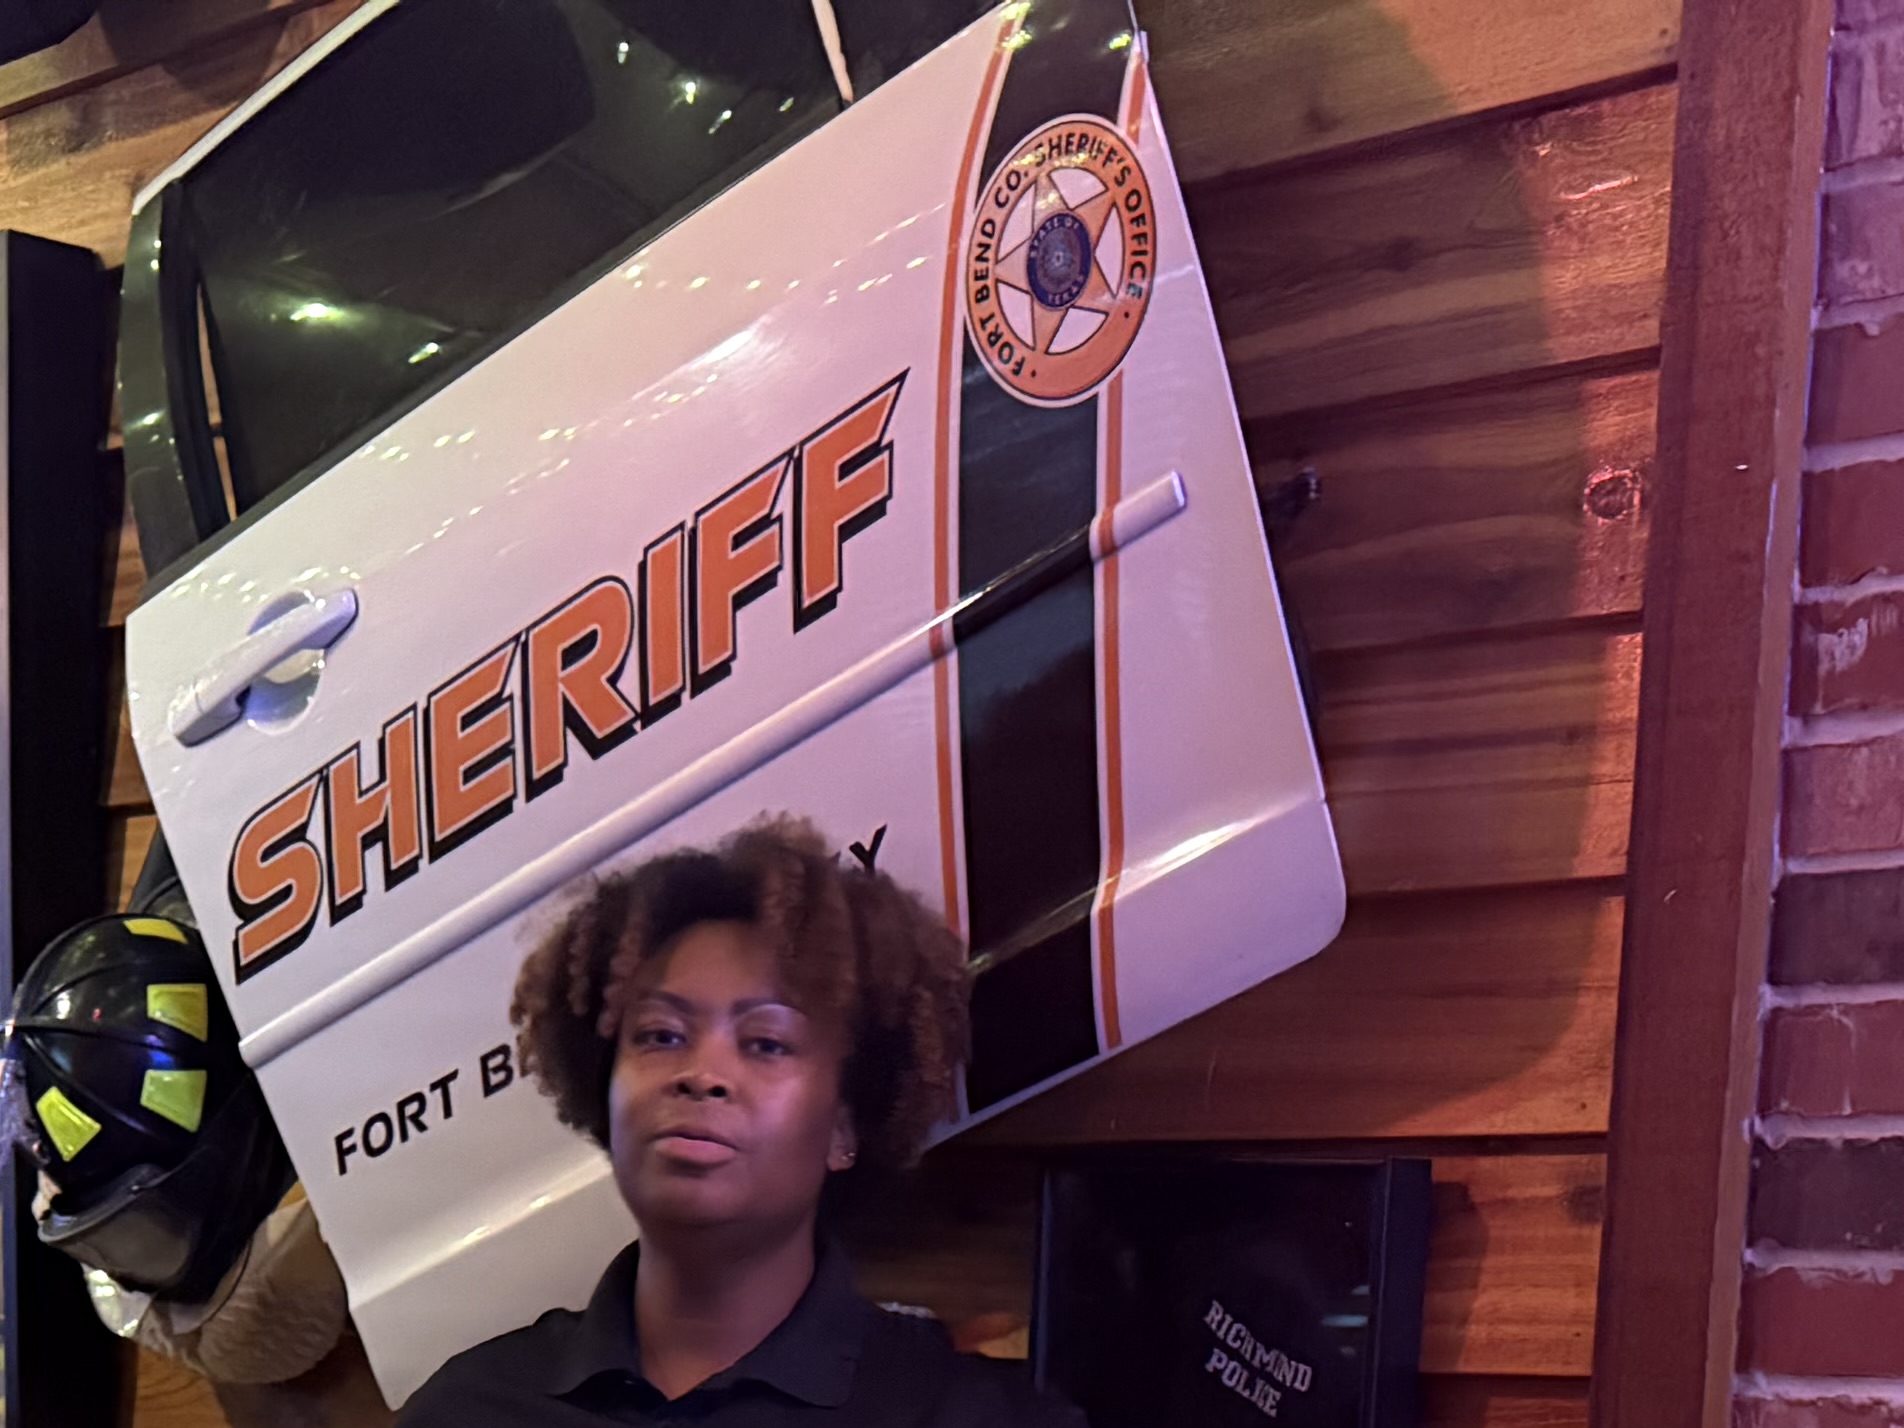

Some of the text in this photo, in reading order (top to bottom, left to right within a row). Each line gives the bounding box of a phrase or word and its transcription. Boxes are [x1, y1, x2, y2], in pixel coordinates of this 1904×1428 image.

[974, 132, 1149, 378] FORT BEND CO. SHERIFF'S OFFICE
[231, 367, 912, 985] SHERIFF
[332, 1068, 461, 1176] FORT
